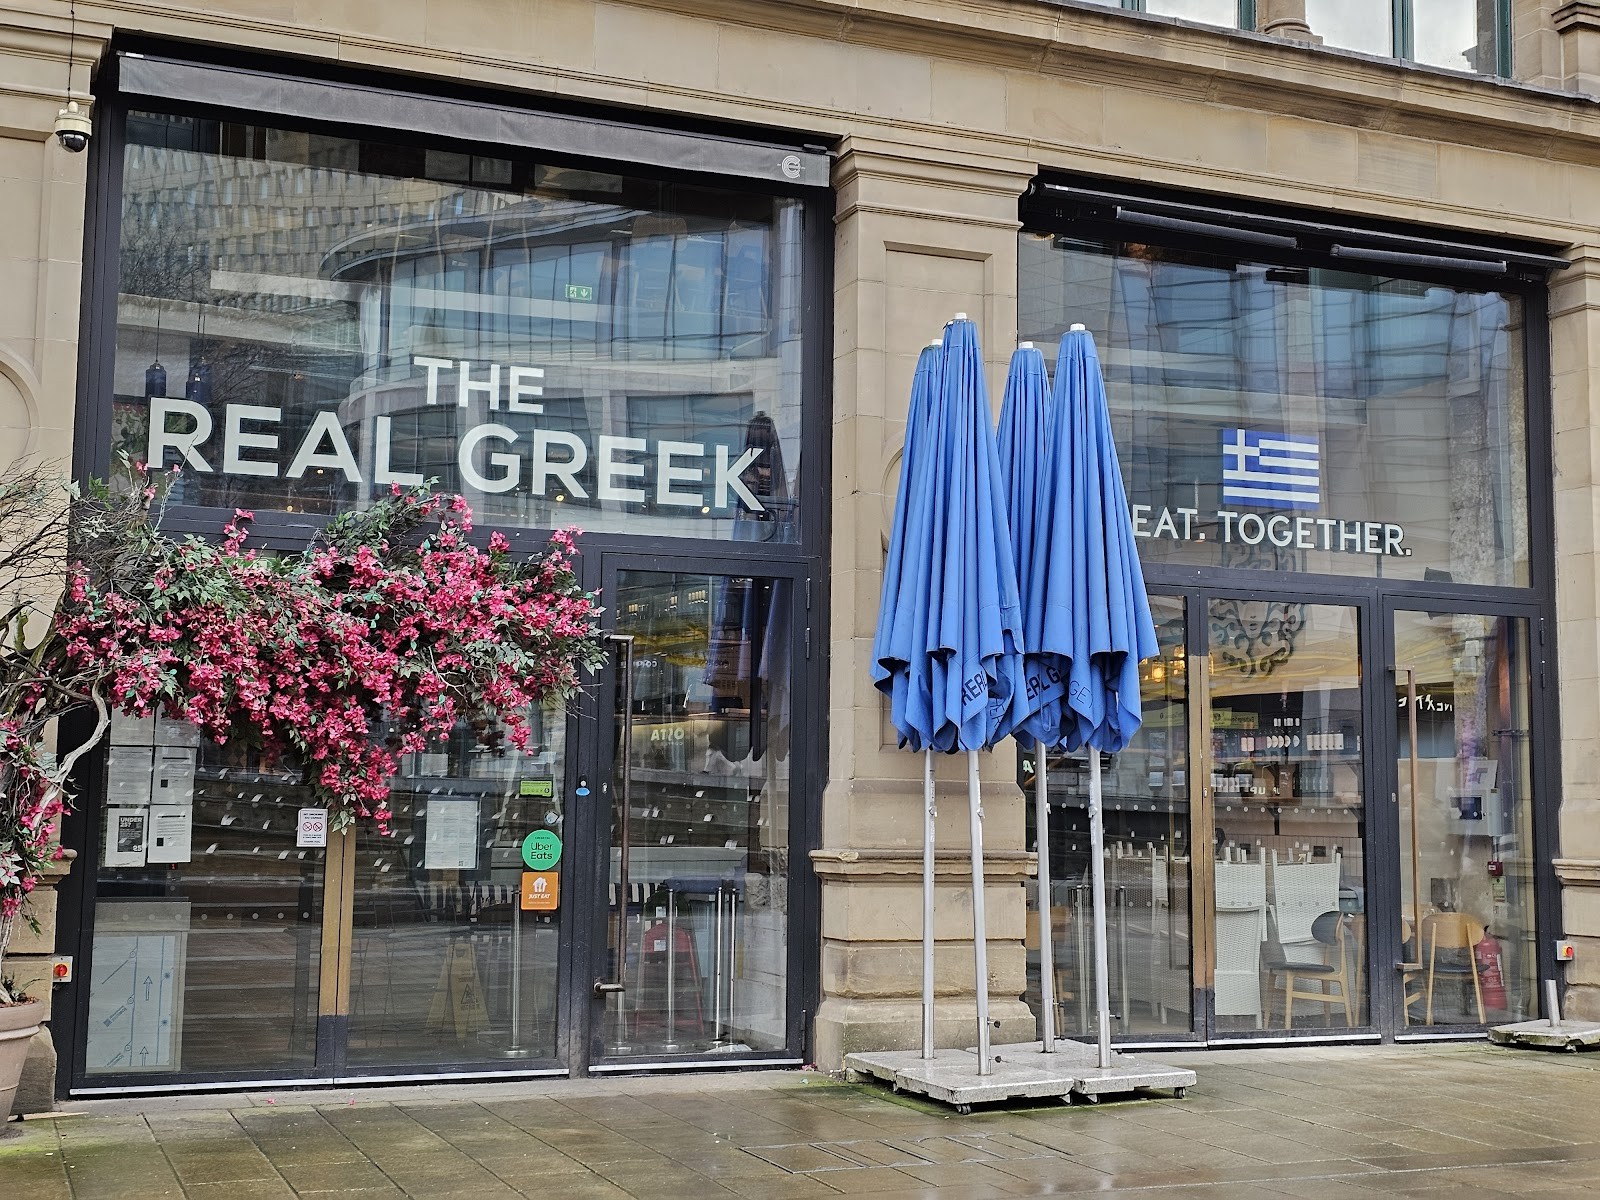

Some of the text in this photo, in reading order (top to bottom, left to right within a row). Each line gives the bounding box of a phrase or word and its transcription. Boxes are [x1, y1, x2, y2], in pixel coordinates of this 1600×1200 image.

[413, 356, 545, 414] THE
[148, 396, 766, 512] REAL GREEK
[1131, 504, 1412, 556] EAT. TOGETHER.
[530, 842, 553, 851] Uber
[530, 851, 553, 860] Eats
